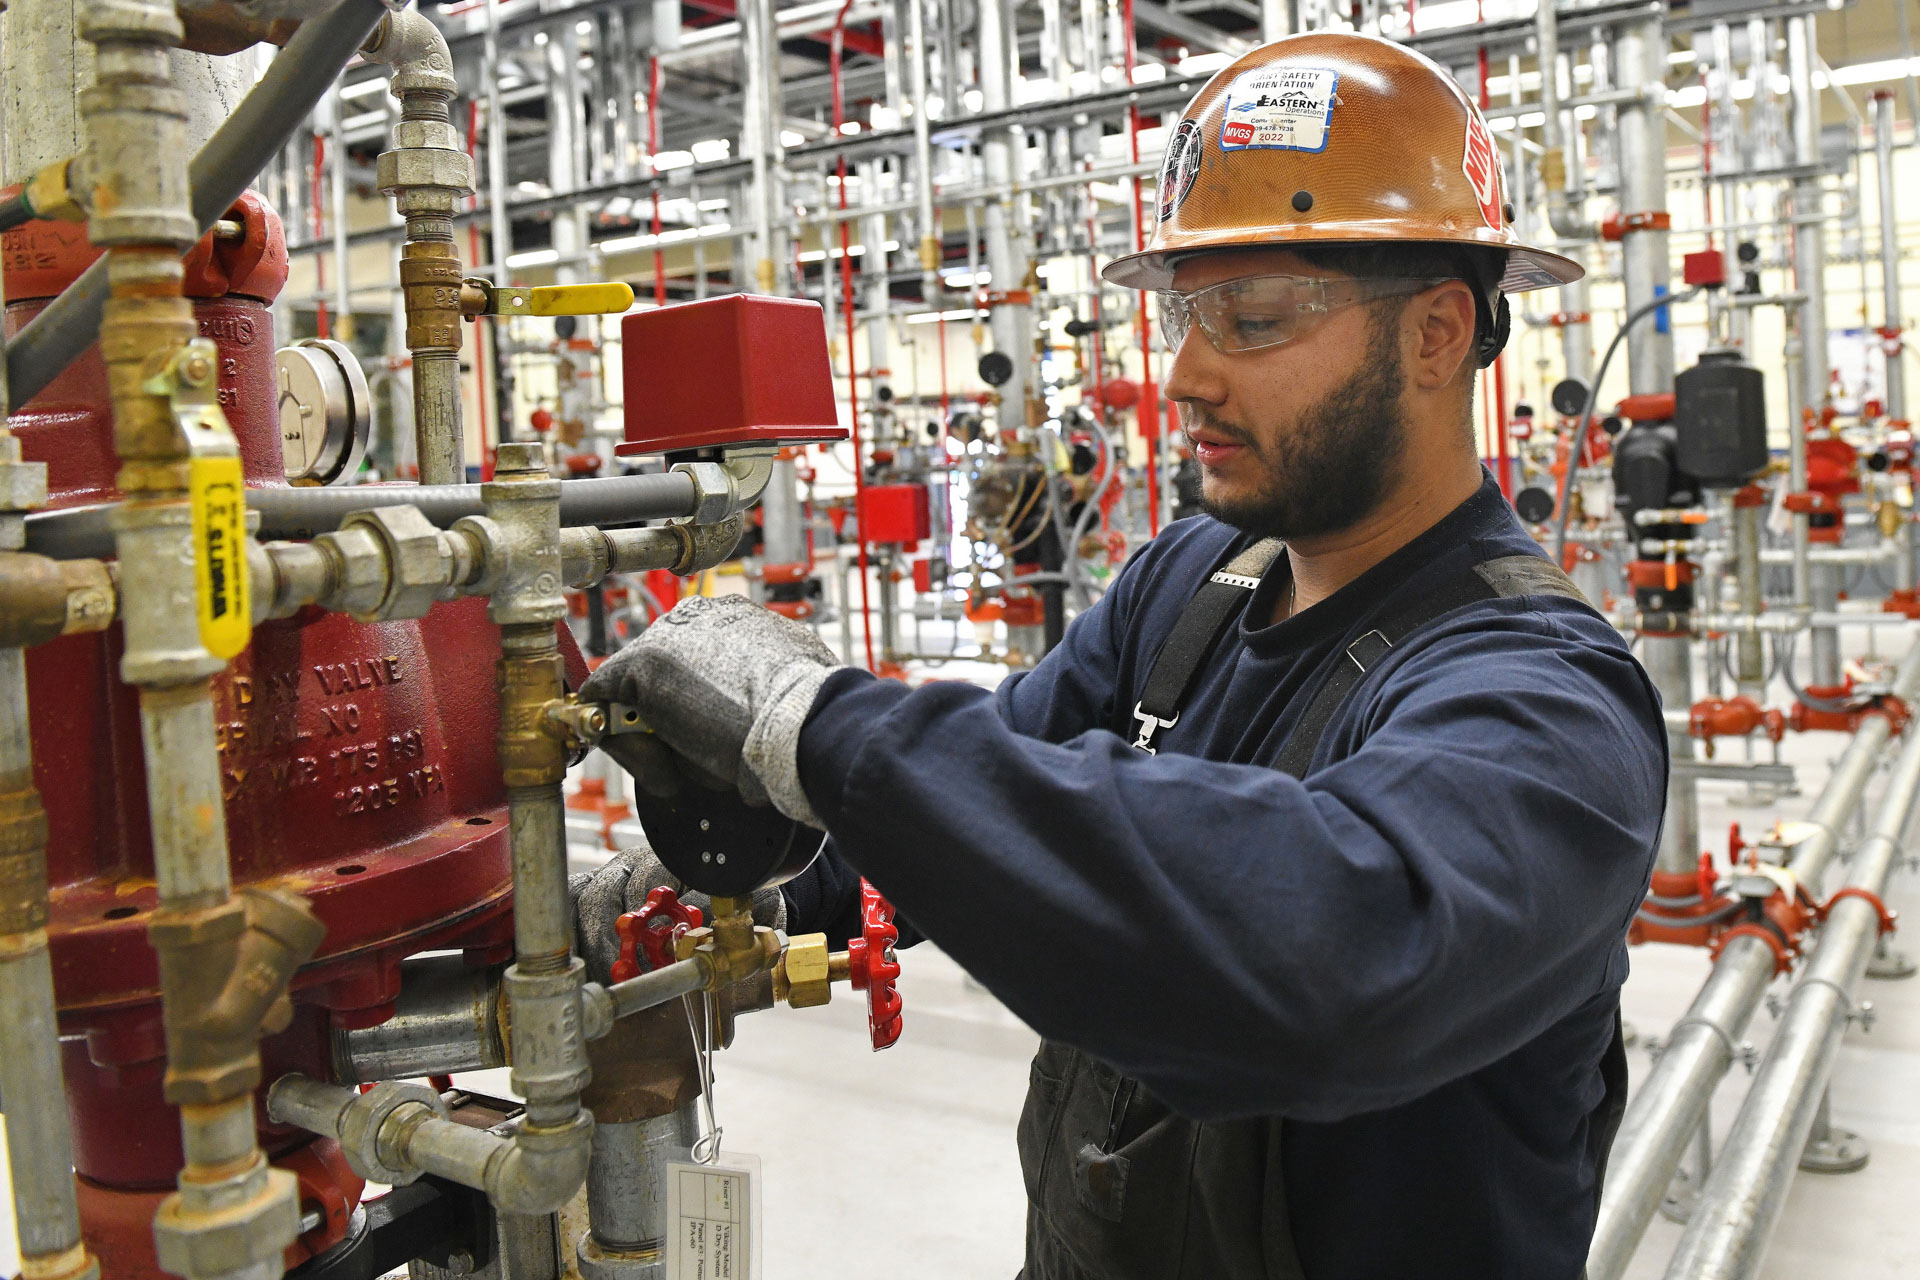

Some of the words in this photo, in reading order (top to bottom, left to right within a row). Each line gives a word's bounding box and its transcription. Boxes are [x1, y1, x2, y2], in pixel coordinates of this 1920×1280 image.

[1281, 72, 1320, 80] SAFETY
[1250, 81, 1315, 89] ORIENTATION
[1257, 95, 1318, 109] EASTERN
[1285, 107, 1325, 116] Operations
[1225, 127, 1252, 139] MVGS
[1258, 133, 1284, 141] 2022
[314, 656, 402, 696] VALVE
[714, 1233, 722, 1246] Dry
[722, 1225, 730, 1251] Viking
